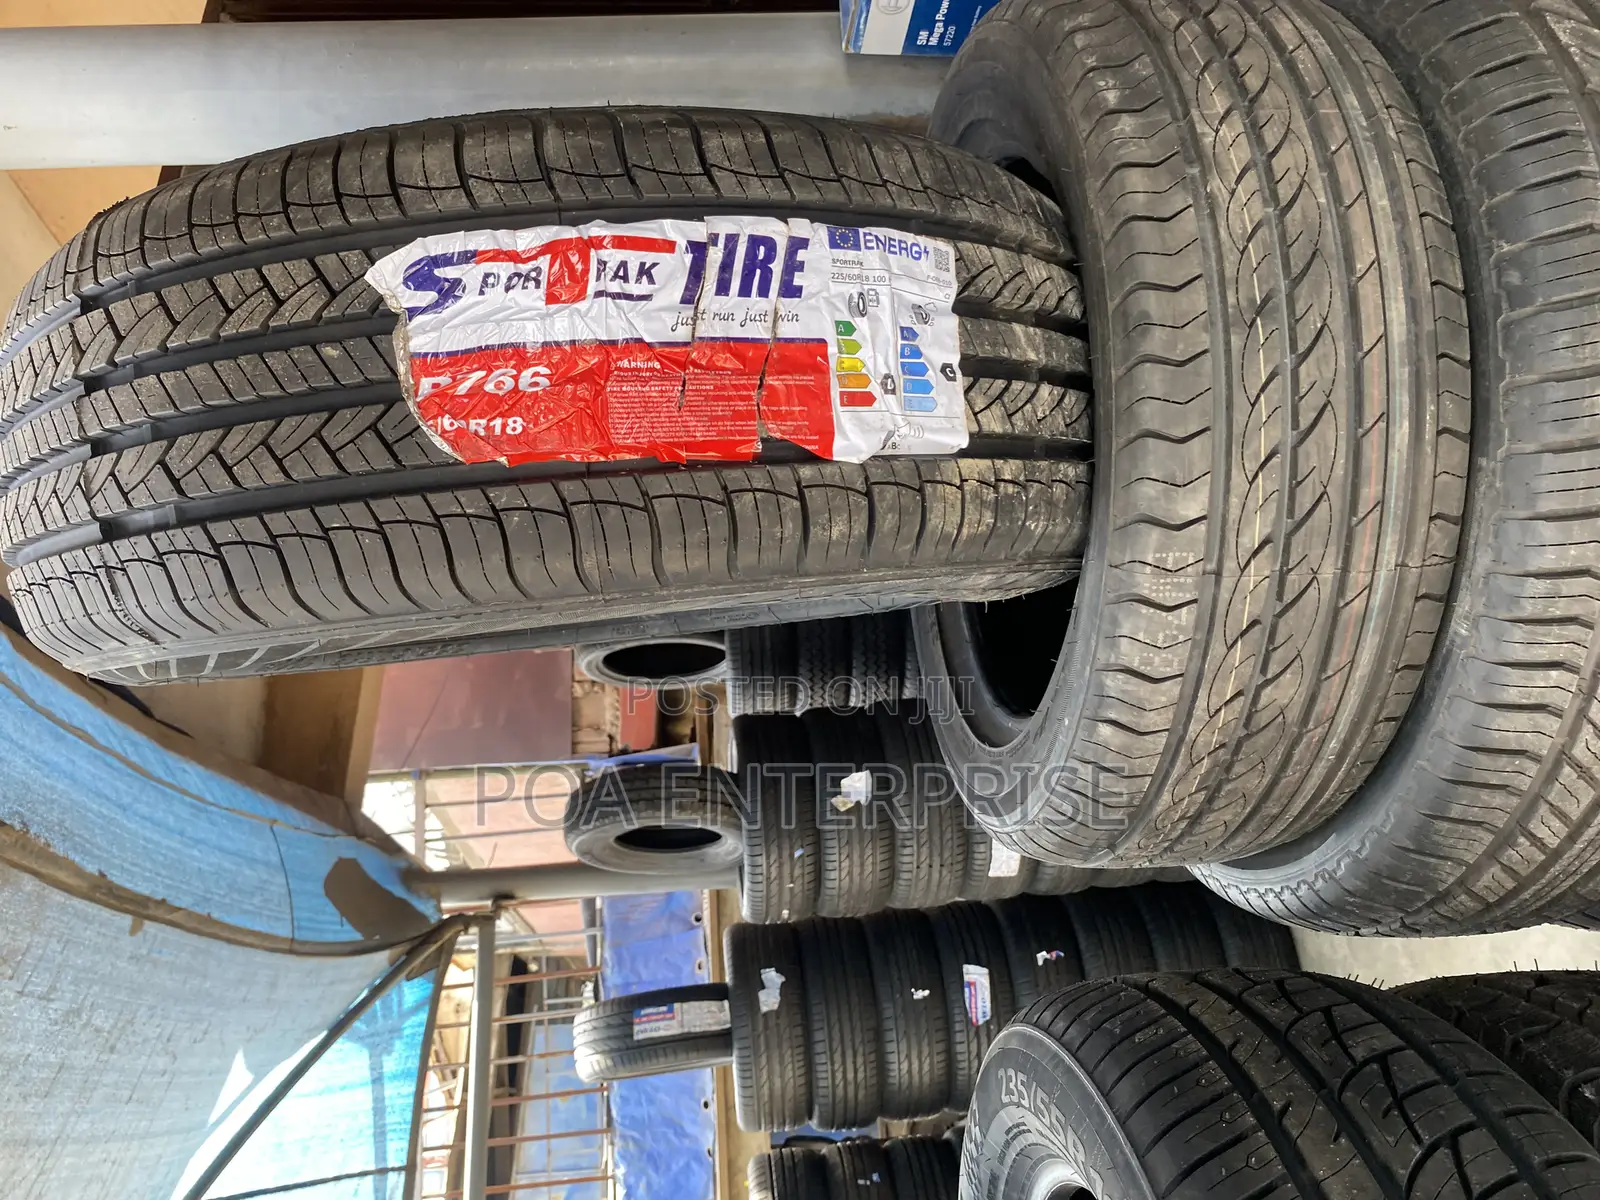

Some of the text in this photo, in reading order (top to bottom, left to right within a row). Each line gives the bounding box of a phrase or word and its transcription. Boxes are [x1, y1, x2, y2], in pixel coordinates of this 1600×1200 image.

[917, 29, 930, 46] SM
[927, 21, 944, 46] Mega
[943, 25, 956, 47] 57220
[863, 231, 922, 261] ENERG
[680, 231, 809, 304] TIRE
[831, 272, 869, 283] 225/60R18
[872, 275, 886, 283] 100
[670, 309, 707, 332] just
[712, 311, 735, 322] run
[740, 307, 768, 328] just
[837, 324, 845, 333] A
[904, 347, 911, 356] B
[616, 360, 660, 369] WARNING
[945, 367, 954, 377] C
